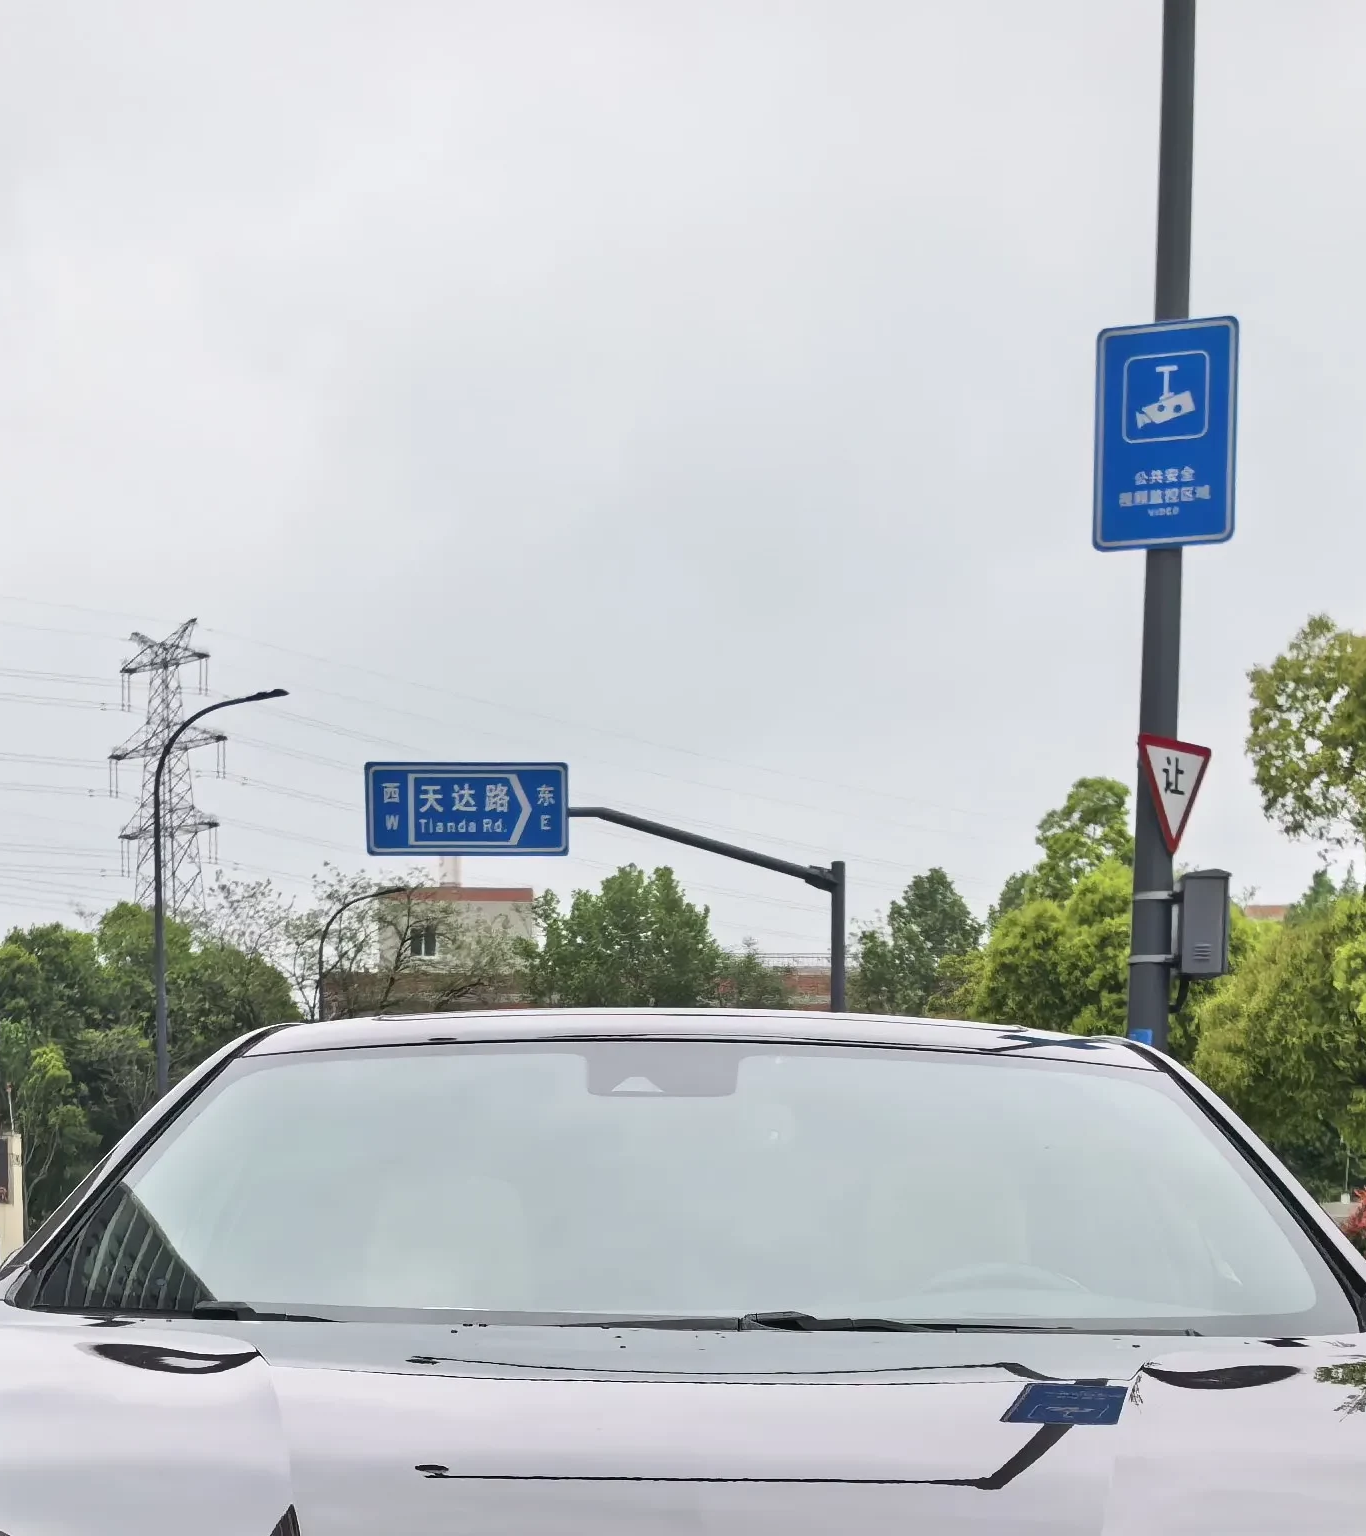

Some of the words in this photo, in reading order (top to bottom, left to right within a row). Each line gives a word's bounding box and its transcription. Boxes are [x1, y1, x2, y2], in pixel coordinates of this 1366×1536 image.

[1162, 756, 1186, 796] 让
[381, 782, 401, 804] 西
[419, 783, 510, 813] 天达路
[536, 784, 556, 807] 东
[385, 814, 400, 831] W
[540, 814, 552, 831] E
